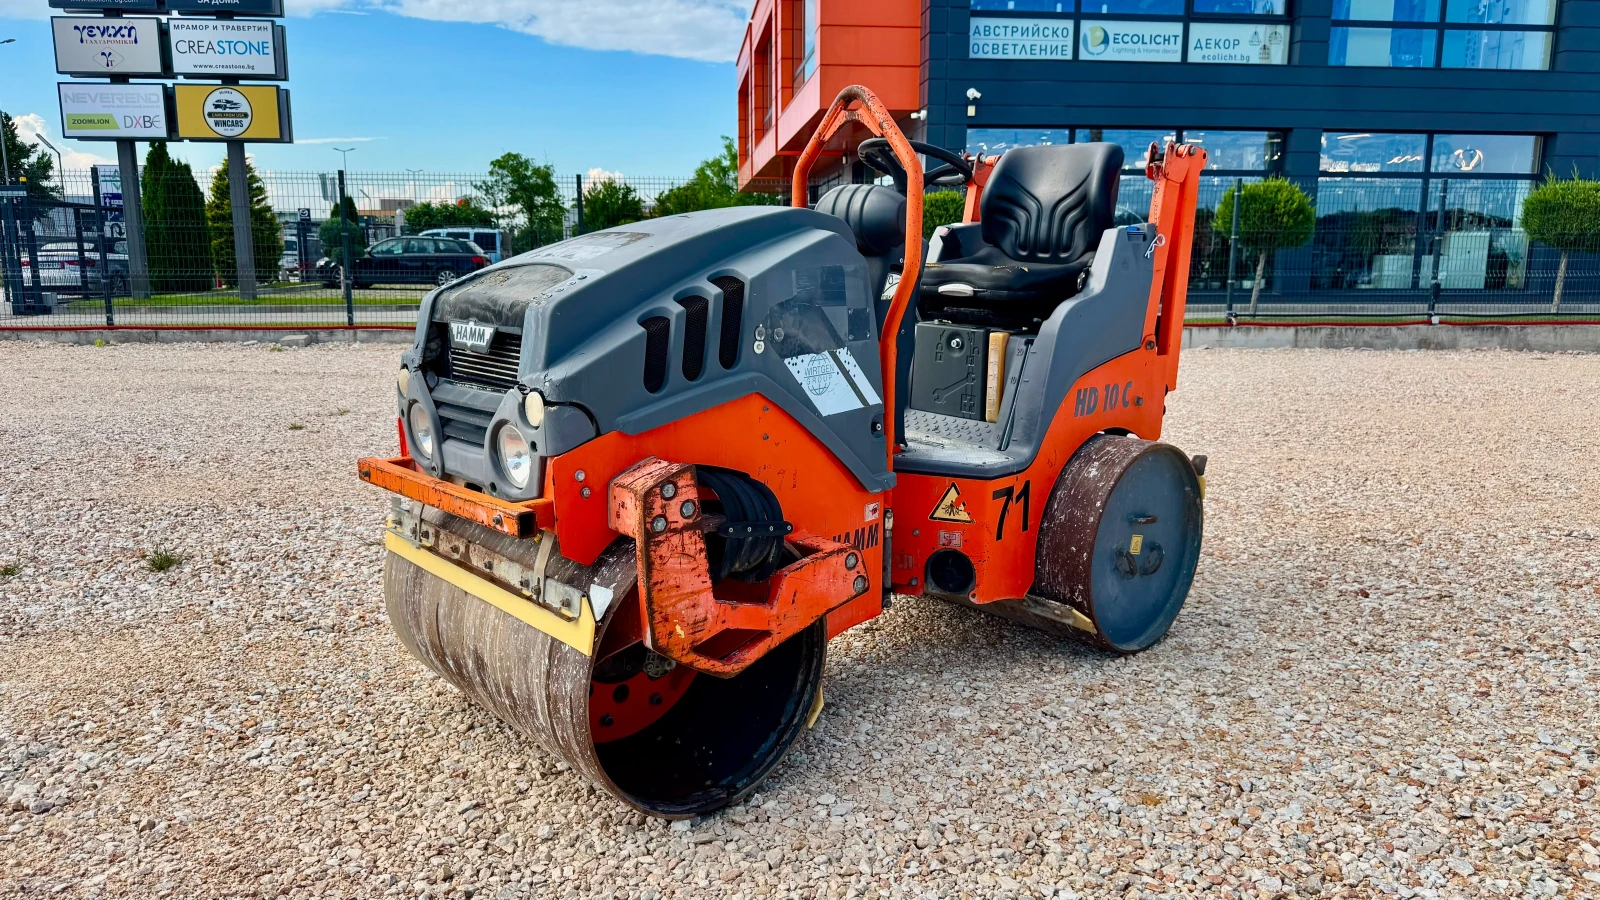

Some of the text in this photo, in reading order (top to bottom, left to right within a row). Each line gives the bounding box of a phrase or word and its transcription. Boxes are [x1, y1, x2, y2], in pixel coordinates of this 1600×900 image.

[972, 23, 1069, 38] АВСТРИЙСКО
[1112, 33, 1180, 46] ECOLICHT
[1193, 38, 1240, 51] ДЕКОР
[175, 39, 270, 56] CREASTONE
[972, 43, 1068, 56] ОСВЕТЛЕНИЕ
[1201, 53, 1250, 62] ecolicht.bg
[63, 92, 160, 104] NEVEREND
[213, 119, 244, 128] WINCARS
[455, 324, 486, 344] HAMM
[804, 363, 835, 376] WIRTGEN
[806, 374, 833, 386] GROUP
[1073, 380, 1133, 418] HD 10 C
[992, 479, 1031, 542] 71
